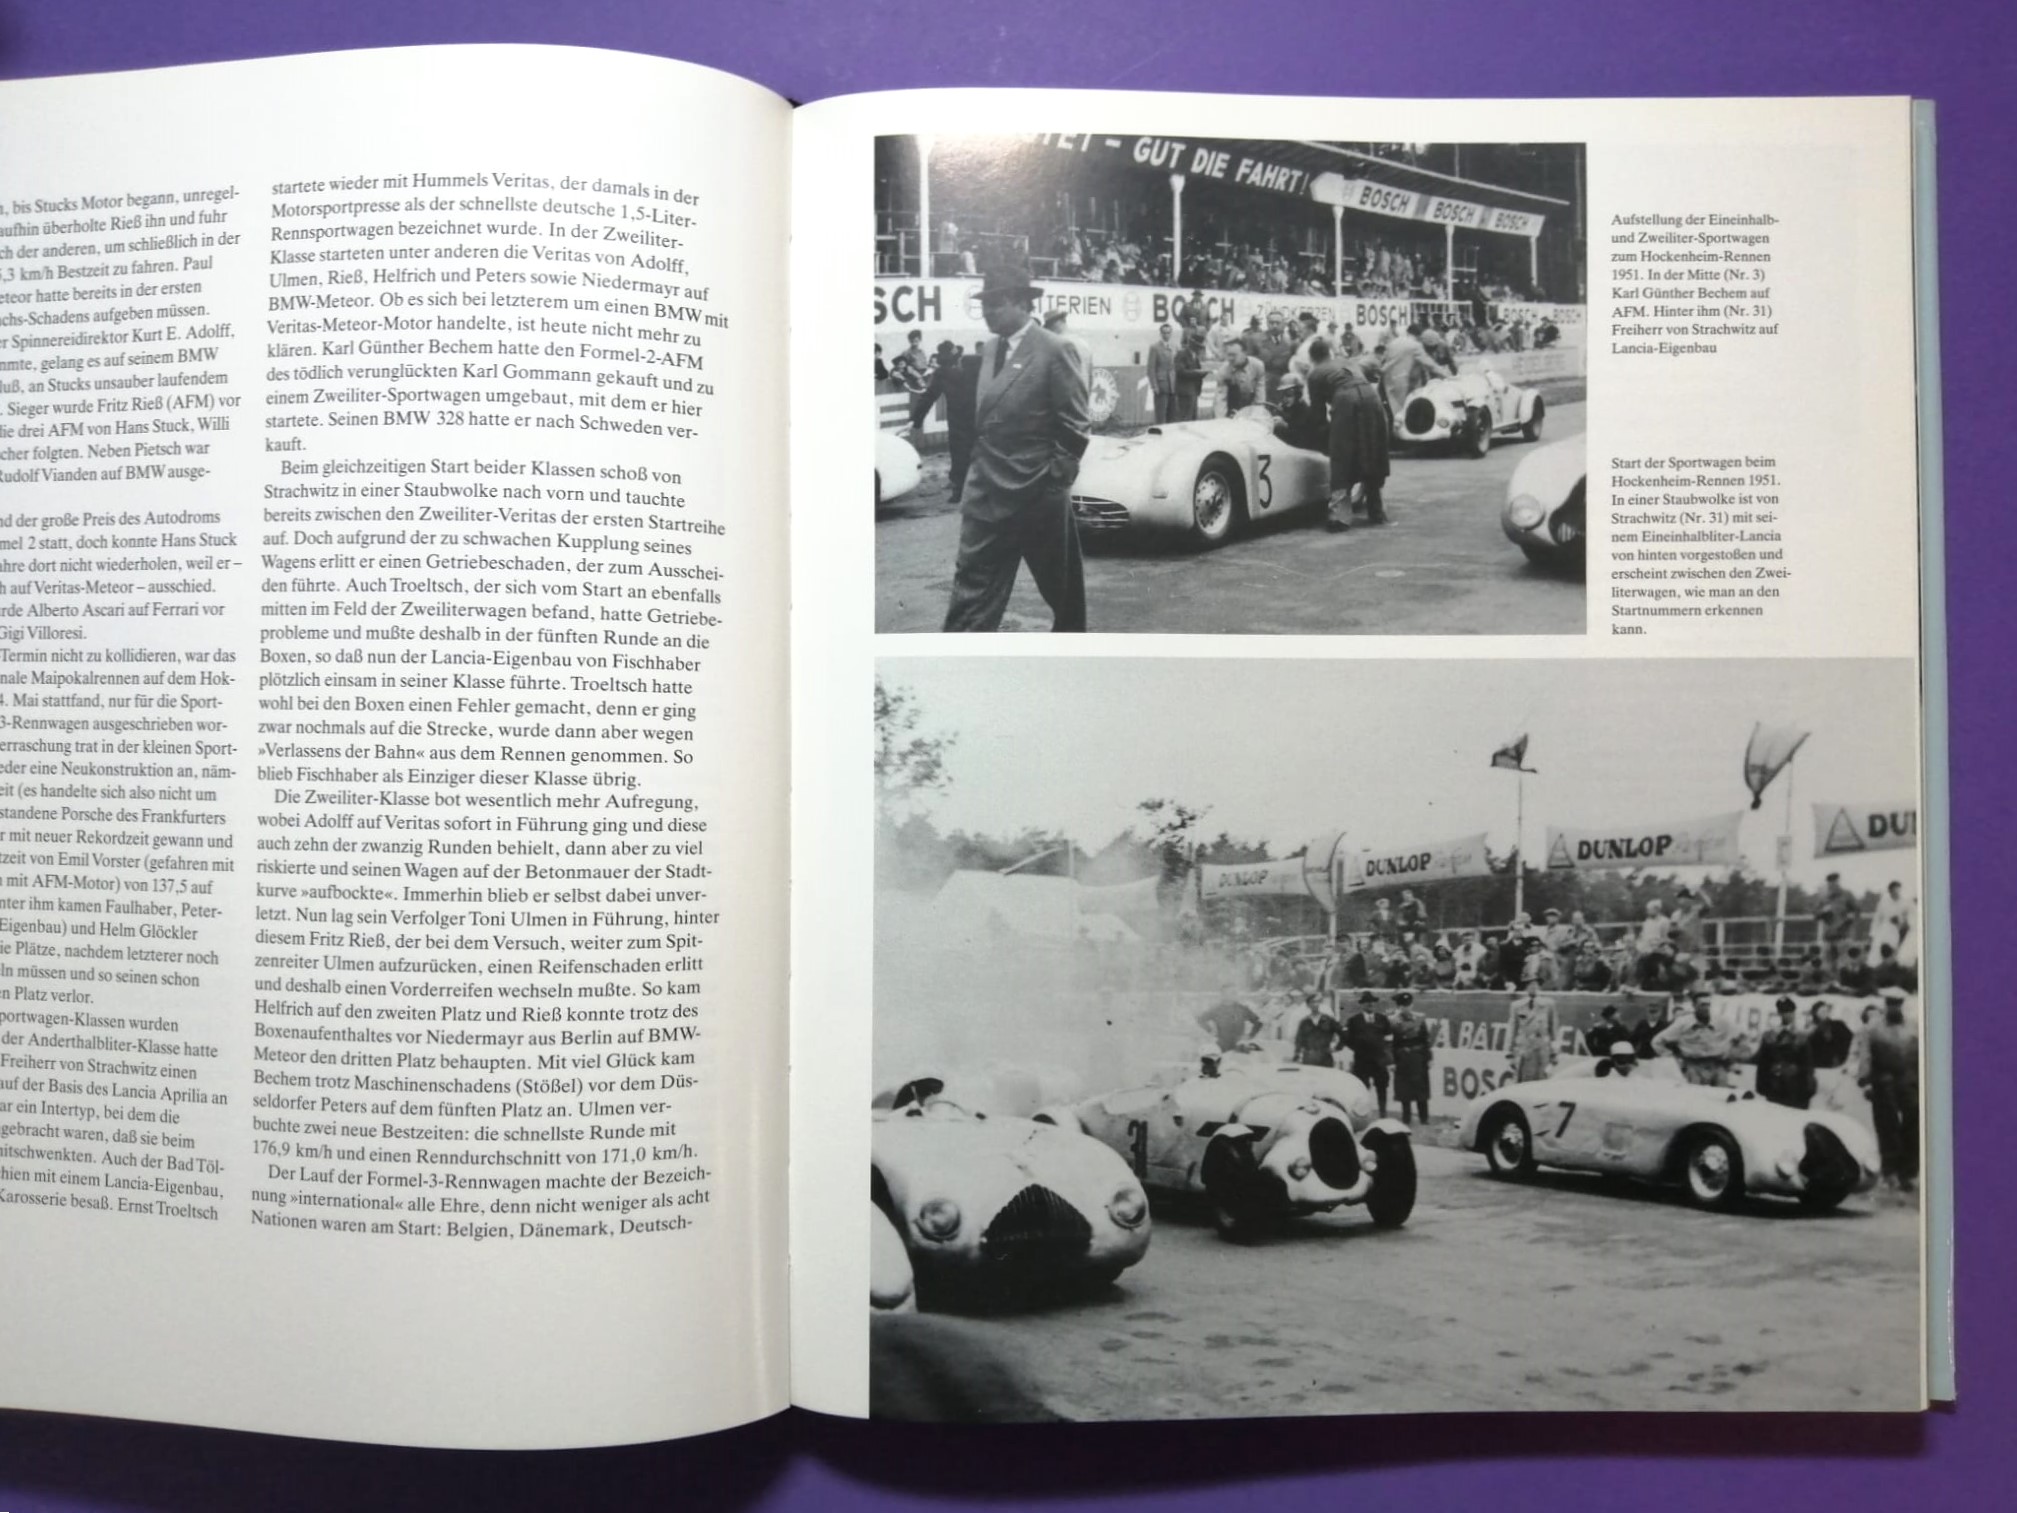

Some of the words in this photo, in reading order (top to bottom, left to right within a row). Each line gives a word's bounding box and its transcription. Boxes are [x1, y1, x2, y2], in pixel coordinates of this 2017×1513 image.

[1133, 137, 1186, 169] GUT
[1190, 148, 1231, 178] DIE
[1235, 158, 1309, 195] FAHRT!
[272, 180, 325, 195] startete
[328, 175, 379, 190] wieder
[383, 176, 408, 188] mit
[412, 173, 488, 188] Hummels
[493, 173, 554, 189] Veritas,
[560, 177, 587, 191] der
[592, 179, 649, 198] damals
[654, 189, 668, 201] in
[673, 189, 699, 206] der
[1359, 186, 1411, 213] BOSCH
[1433, 201, 1477, 223] BOSCH
[1611, 213, 1683, 228] Aufstellung
[1685, 213, 1706, 225] der
[1708, 213, 1779, 225] Eineinhalb-
[1494, 212, 1530, 230] BOSCH
[271, 225, 393, 243] Rennsportwagen
[398, 220, 482, 235] bezeichnet
[486, 222, 542, 236] wurde.
[549, 223, 565, 237] In
[570, 224, 598, 239] der
[603, 227, 683, 249] Zweiliter-
[1611, 231, 1635, 243] und
[1638, 231, 1770, 247] Zweiliter-Sportwagen
[1611, 253, 1637, 262] zum
[1640, 250, 1771, 262] Hockenheim-Rennen
[1612, 268, 1644, 280] 1951.
[1648, 268, 1661, 280] In
[1663, 269, 1685, 281] der
[1687, 268, 1721, 280] Mitte
[1723, 268, 1749, 281] (Nr.
[1752, 268, 1765, 282] 3)
[1612, 287, 1639, 299] Karl
[1642, 286, 1695, 299] Günther
[1697, 287, 1747, 299] Bechem
[1750, 287, 1770, 298] auf
[1153, 293, 1234, 324] BOCH
[1356, 303, 1409, 327] BOSCH
[1611, 305, 1649, 318] AFM.
[1653, 305, 1695, 317] Hinter
[1696, 305, 1720, 317] ihm
[1723, 304, 1749, 318] (Nr.
[1753, 304, 1772, 318] 31)
[266, 316, 433, 334] Veritas-Meteor-Motor
[437, 316, 512, 331] handelte,
[517, 319, 535, 331] ist
[541, 318, 587, 334] heute
[592, 323, 632, 338] nicht
[637, 328, 680, 343] mehr
[683, 334, 701, 347] zu
[1611, 323, 1663, 336] Freiherr
[1665, 326, 1689, 335] von
[1691, 323, 1756, 335] Strachwitz
[1758, 323, 1779, 335] auf
[1612, 341, 1717, 357] Lancia-Eigenbau
[7, 401, 50, 419] Sieger
[52, 399, 94, 414] wurde
[97, 398, 128, 413] Fritz
[131, 395, 163, 411] Rieß
[166, 393, 215, 411] (AFM)
[218, 396, 241, 407] vor
[265, 437, 306, 452] kauft.
[1611, 457, 1641, 469] Start
[1644, 457, 1665, 469] der
[1668, 456, 1742, 471] Sportwagen
[1745, 455, 1776, 467] beim
[1257, 454, 1273, 509] 3
[1611, 474, 1745, 487] Hockenheim-Rennen
[1749, 474, 1781, 486] 1951.
[1611, 494, 1625, 506] In
[1627, 493, 1660, 505] einer
[1662, 492, 1736, 505] Staubwolke
[1738, 492, 1753, 504] ist
[1756, 495, 1779, 504] von
[1611, 511, 1676, 524] Strachwitz
[1679, 511, 1705, 525] (Nr.
[1709, 511, 1729, 525] 31)
[1732, 511, 1753, 523] mit
[1755, 510, 1778, 523] sei-
[1611, 533, 1638, 543] nem
[1641, 529, 1782, 542] Eineinhalbliter-Lancia
[1611, 552, 1634, 561] von
[1637, 549, 1677, 561] hinten
[1679, 548, 1756, 563] vorgestoßen
[1759, 548, 1783, 560] und
[1611, 567, 1667, 579] erscheint
[1670, 567, 1726, 579] zwischen
[1728, 566, 1752, 579] den
[1755, 566, 1792, 579] Zwei-
[1611, 586, 1681, 601] literwagen,
[1684, 585, 1705, 598] wie
[1708, 588, 1735, 597] man
[1738, 588, 1754, 597] an
[1756, 585, 1780, 597] den
[1611, 604, 1702, 616] Startnummern
[1704, 604, 1763, 616] erkennen
[27, 625, 87, 640] Villoresi.
[1611, 623, 1647, 635] kann.
[260, 648, 311, 664] Boxen,
[315, 652, 331, 663] so
[334, 649, 363, 663] daß
[367, 652, 396, 664] nun
[400, 650, 427, 664] der
[431, 650, 572, 670] Lancia-Eigenbau
[576, 656, 607, 668] von
[612, 655, 701, 672] Fischhaber
[1577, 834, 1673, 861] DUNLOP
[1366, 852, 1432, 877] DUNLOP
[1218, 869, 1269, 888] DUNLOP
[254, 956, 320, 969] zenreiter
[324, 956, 374, 971] Ulmen
[378, 958, 483, 975] aufzurücken,
[487, 962, 533, 974] einen
[538, 959, 661, 974] Reifenschaden
[664, 957, 703, 972] erlitt
[1, 1030, 24, 1045] der
[27, 1032, 180, 1055] Anderthalbliter-Klasse
[183, 1041, 218, 1058] hatte
[0, 1053, 57, 1070] Freiherr
[58, 1060, 84, 1072] von
[87, 1058, 157, 1077] Strachwitz
[159, 1066, 197, 1080] einen
[1555, 1101, 1576, 1138] 7
[251, 1211, 317, 1229] Nationen
[321, 1219, 366, 1233] waren
[370, 1222, 394, 1234] am
[398, 1221, 441, 1236] Start:
[446, 1223, 514, 1242] Belgien,
[519, 1221, 614, 1238] Dänemark,
[619, 1215, 693, 1234] Deutsch-
